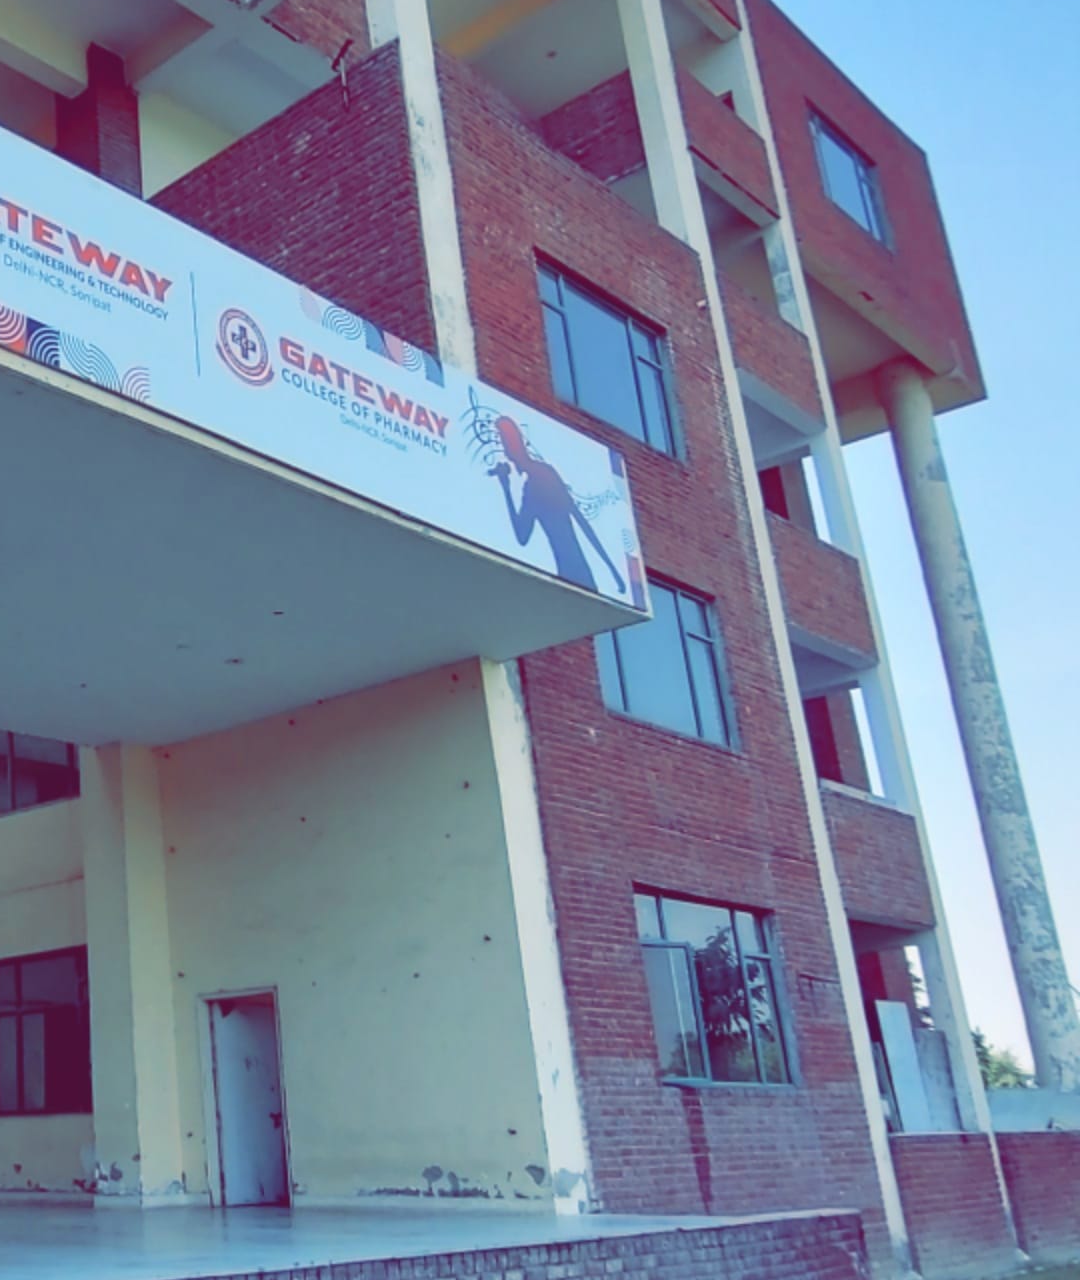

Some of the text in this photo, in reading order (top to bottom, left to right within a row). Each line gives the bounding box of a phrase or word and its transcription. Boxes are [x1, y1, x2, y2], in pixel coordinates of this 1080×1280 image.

[8, 236, 85, 283] ENGINEERING
[87, 275, 96, 287] &
[97, 279, 169, 321] TECHNOLOGY
[279, 336, 448, 438] GATEWAY
[281, 367, 347, 410] COLLEGE
[351, 401, 369, 419] OF
[374, 411, 447, 457] PHARMACY
